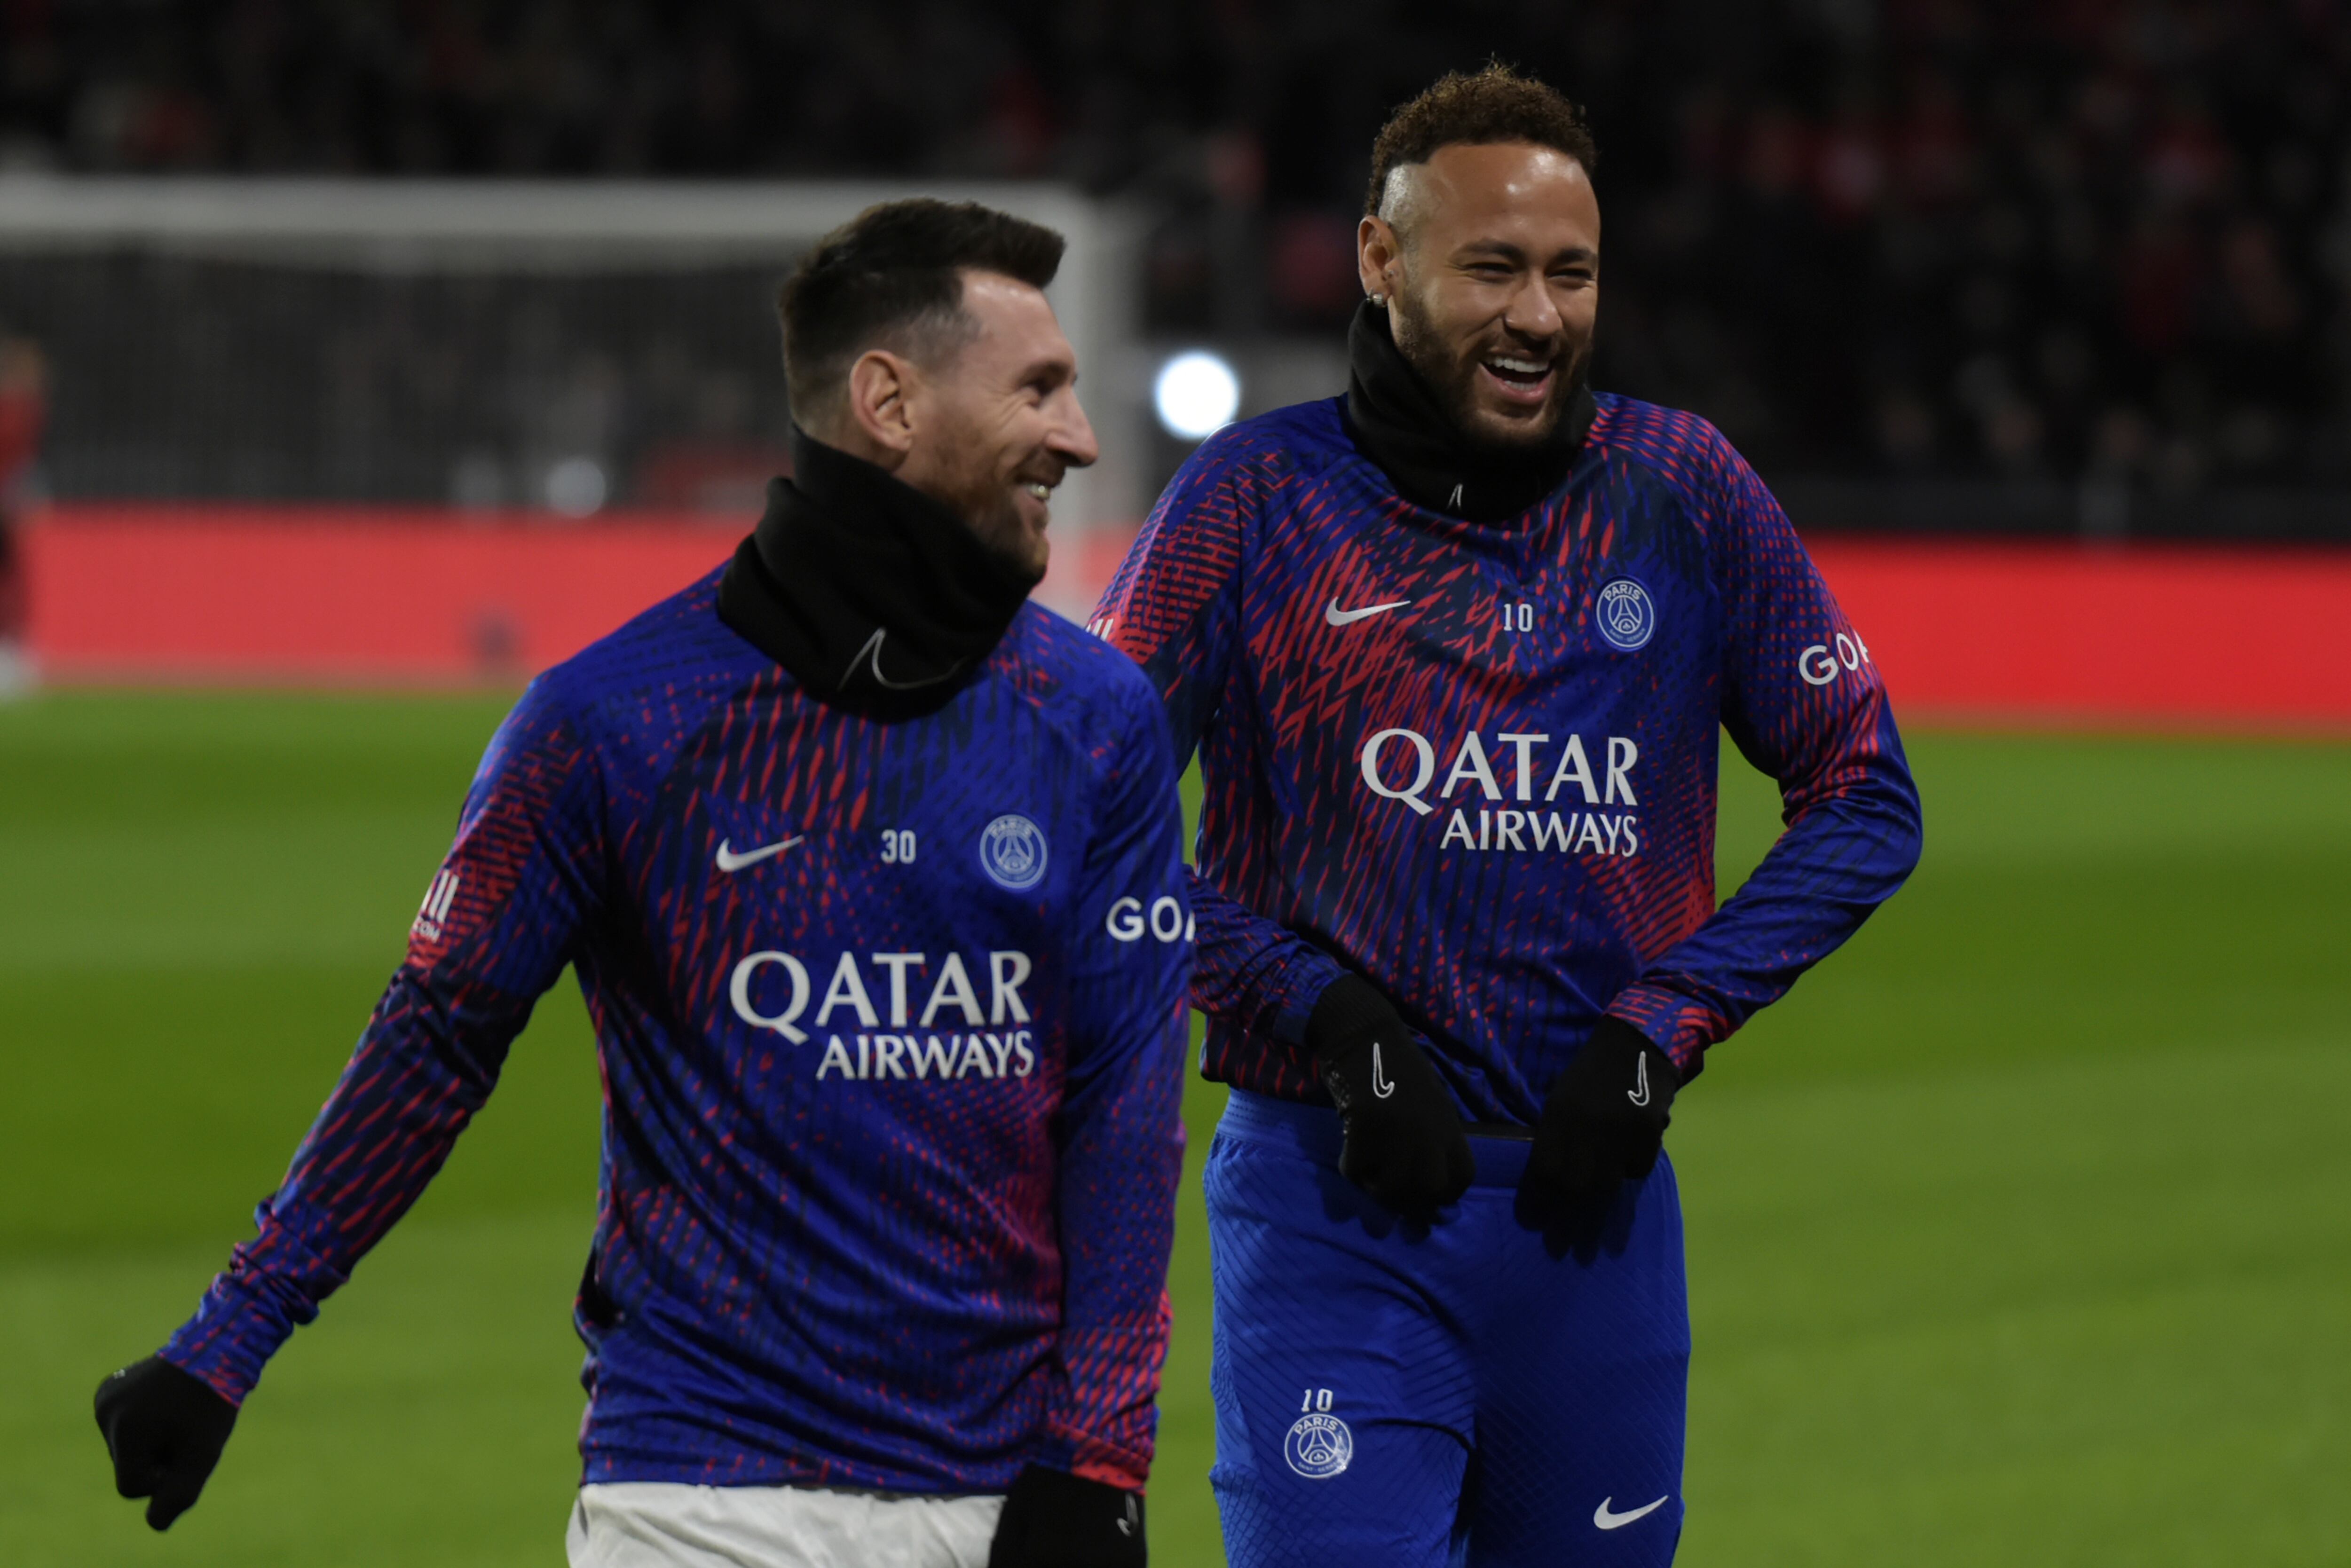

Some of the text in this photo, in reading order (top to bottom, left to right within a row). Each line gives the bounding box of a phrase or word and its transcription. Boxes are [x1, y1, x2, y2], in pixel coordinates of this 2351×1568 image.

[1604, 584, 1641, 601] PARIS
[1503, 603, 1533, 632] 10
[1360, 727, 1638, 816] QATAR
[881, 829, 916, 864] 30
[1440, 808, 1638, 857] AIRWAYS
[730, 951, 1031, 1045] QATAR
[816, 1030, 1034, 1079] AIRWAYS
[1301, 1388, 1333, 1412] 10
[1294, 1417, 1338, 1434] PARIS
